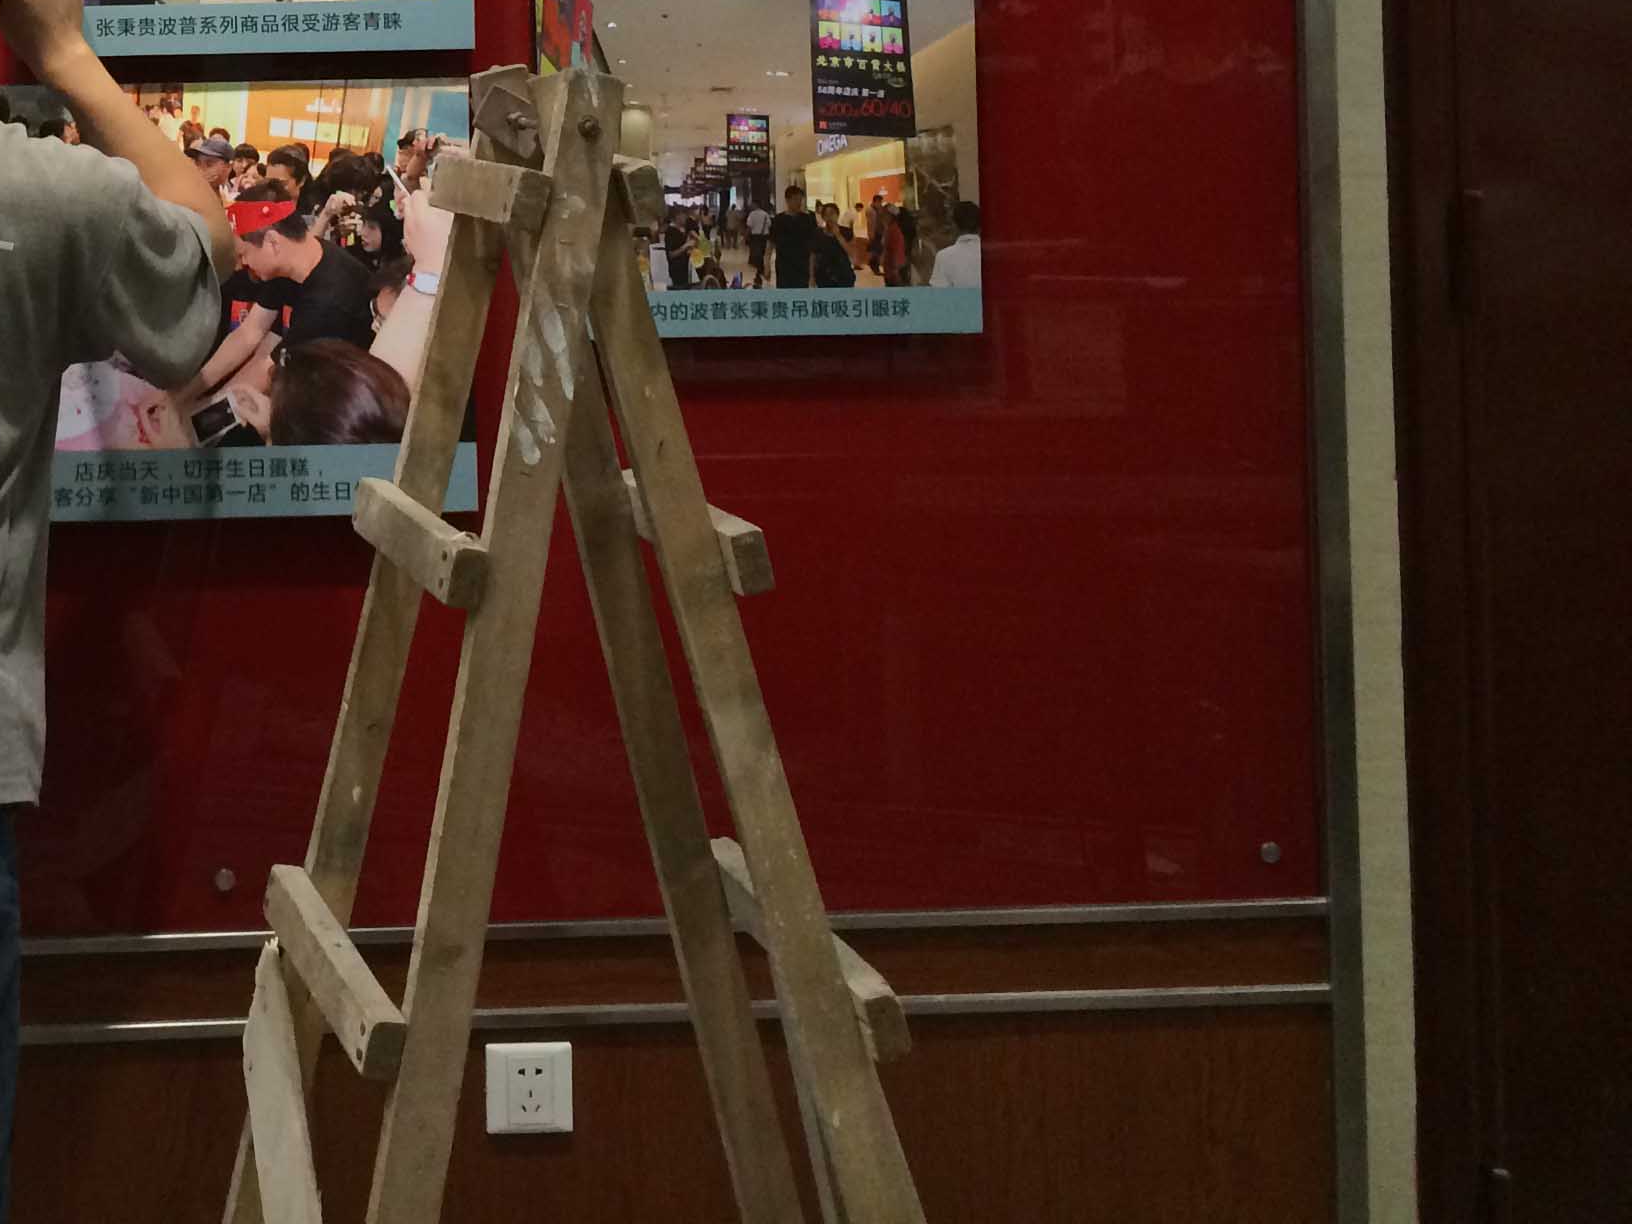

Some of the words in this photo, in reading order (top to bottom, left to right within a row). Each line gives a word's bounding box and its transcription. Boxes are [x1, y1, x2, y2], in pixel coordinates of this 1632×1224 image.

[96, 13, 402, 38] 张秉贵波普系列商品很受游客青睐
[651, 298, 910, 322] 内的波普张秉贵吊旗吸引眼球
[54, 480, 360, 508] 客分享“新中国第一店”的生日
